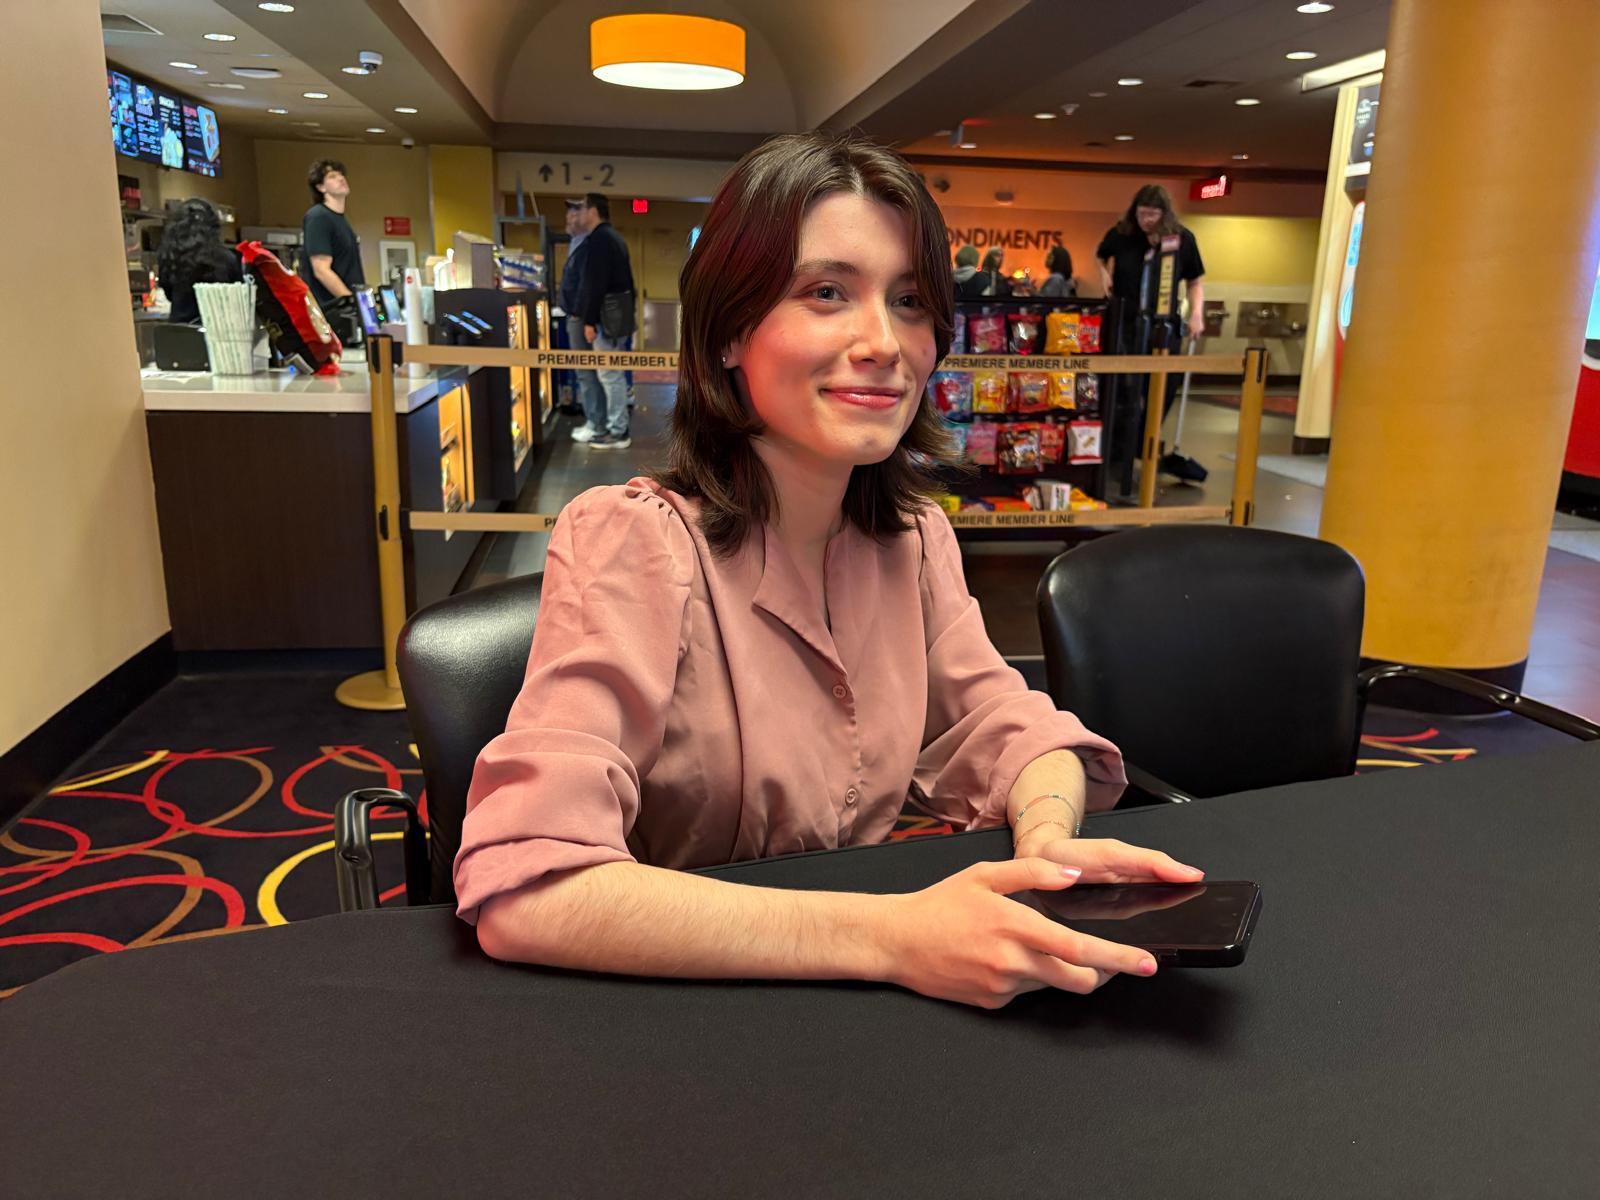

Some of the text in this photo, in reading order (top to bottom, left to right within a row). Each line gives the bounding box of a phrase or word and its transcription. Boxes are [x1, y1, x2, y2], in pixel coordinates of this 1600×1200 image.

[561, 162, 570, 185] 1
[599, 163, 614, 187] 2
[946, 227, 1063, 250] ONDIMENTS
[537, 353, 606, 366] PREMIERE
[609, 354, 666, 367] MEMBER
[943, 357, 1090, 370] PREMIERE MEMBER LINE
[949, 513, 1075, 525] EMIERE MEMBER LINE
